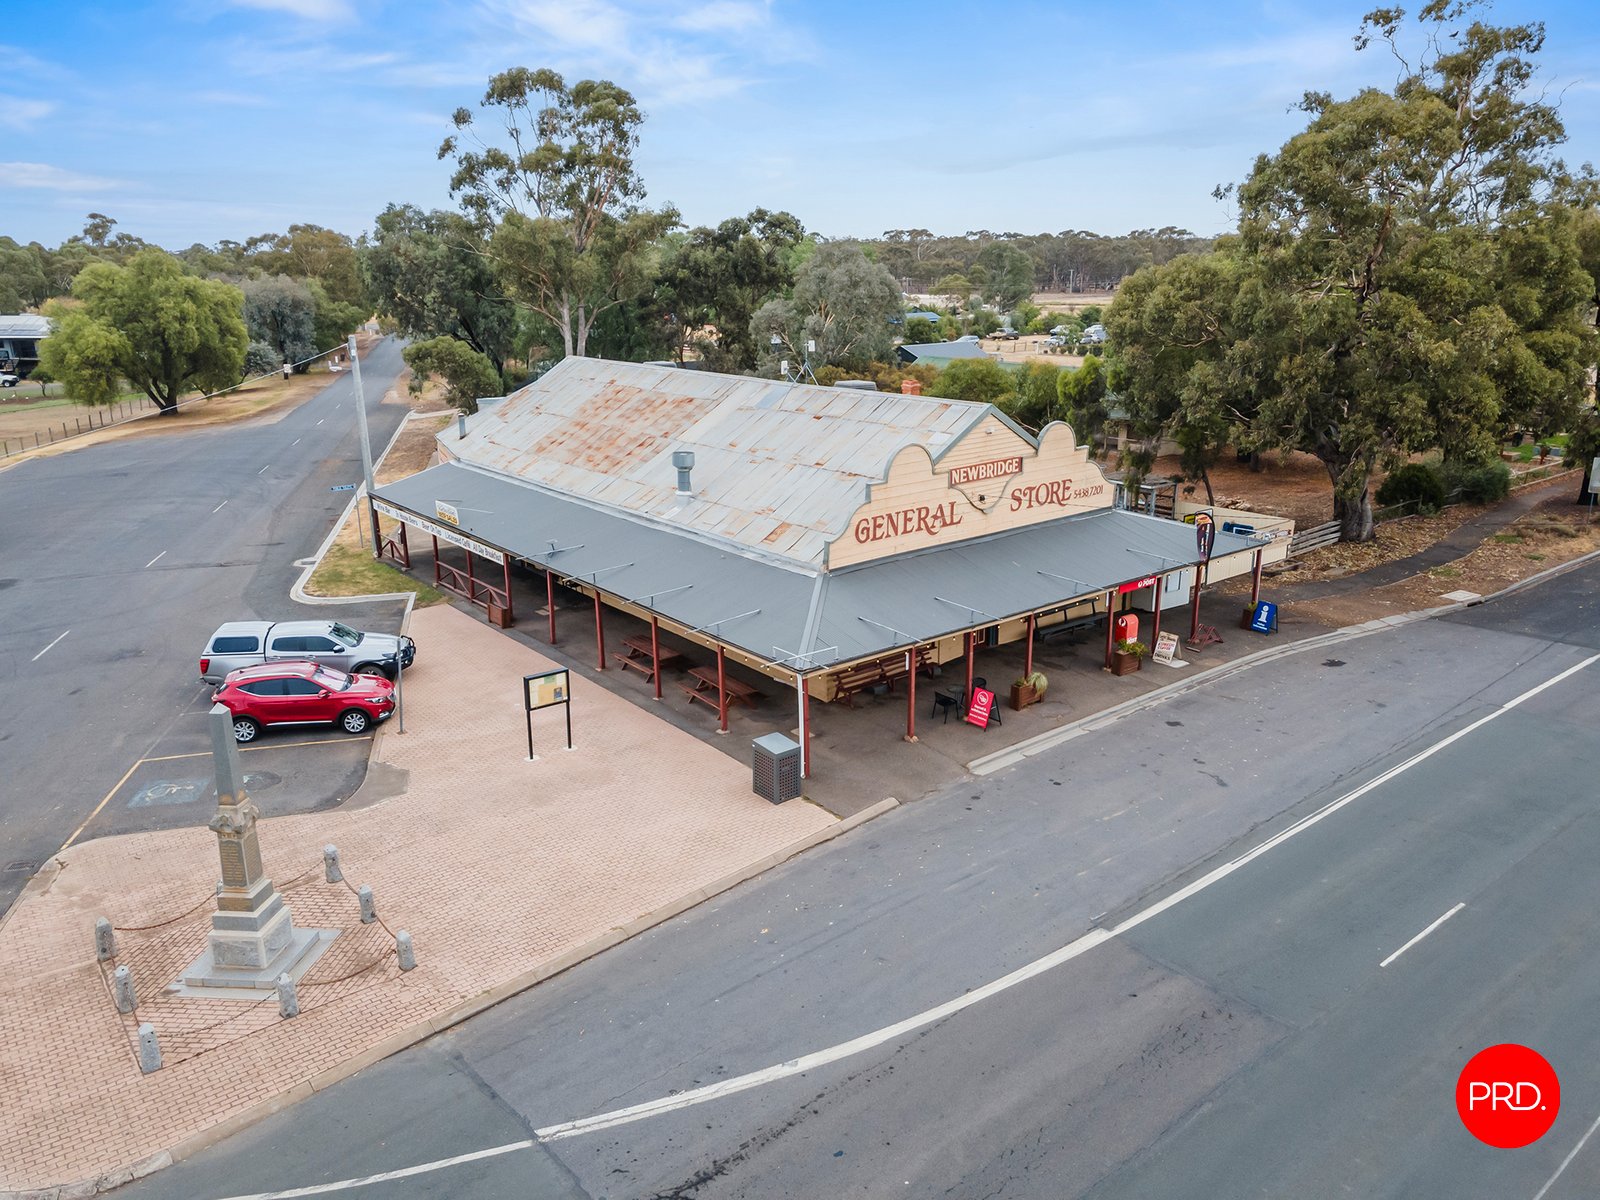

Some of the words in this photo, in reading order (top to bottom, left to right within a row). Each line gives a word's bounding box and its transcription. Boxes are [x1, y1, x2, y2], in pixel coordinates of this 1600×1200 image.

[951, 458, 1019, 484] NEWBRIDGE
[854, 501, 963, 544] GENERAL
[1010, 479, 1073, 512] STORE
[1142, 577, 1156, 587] POST
